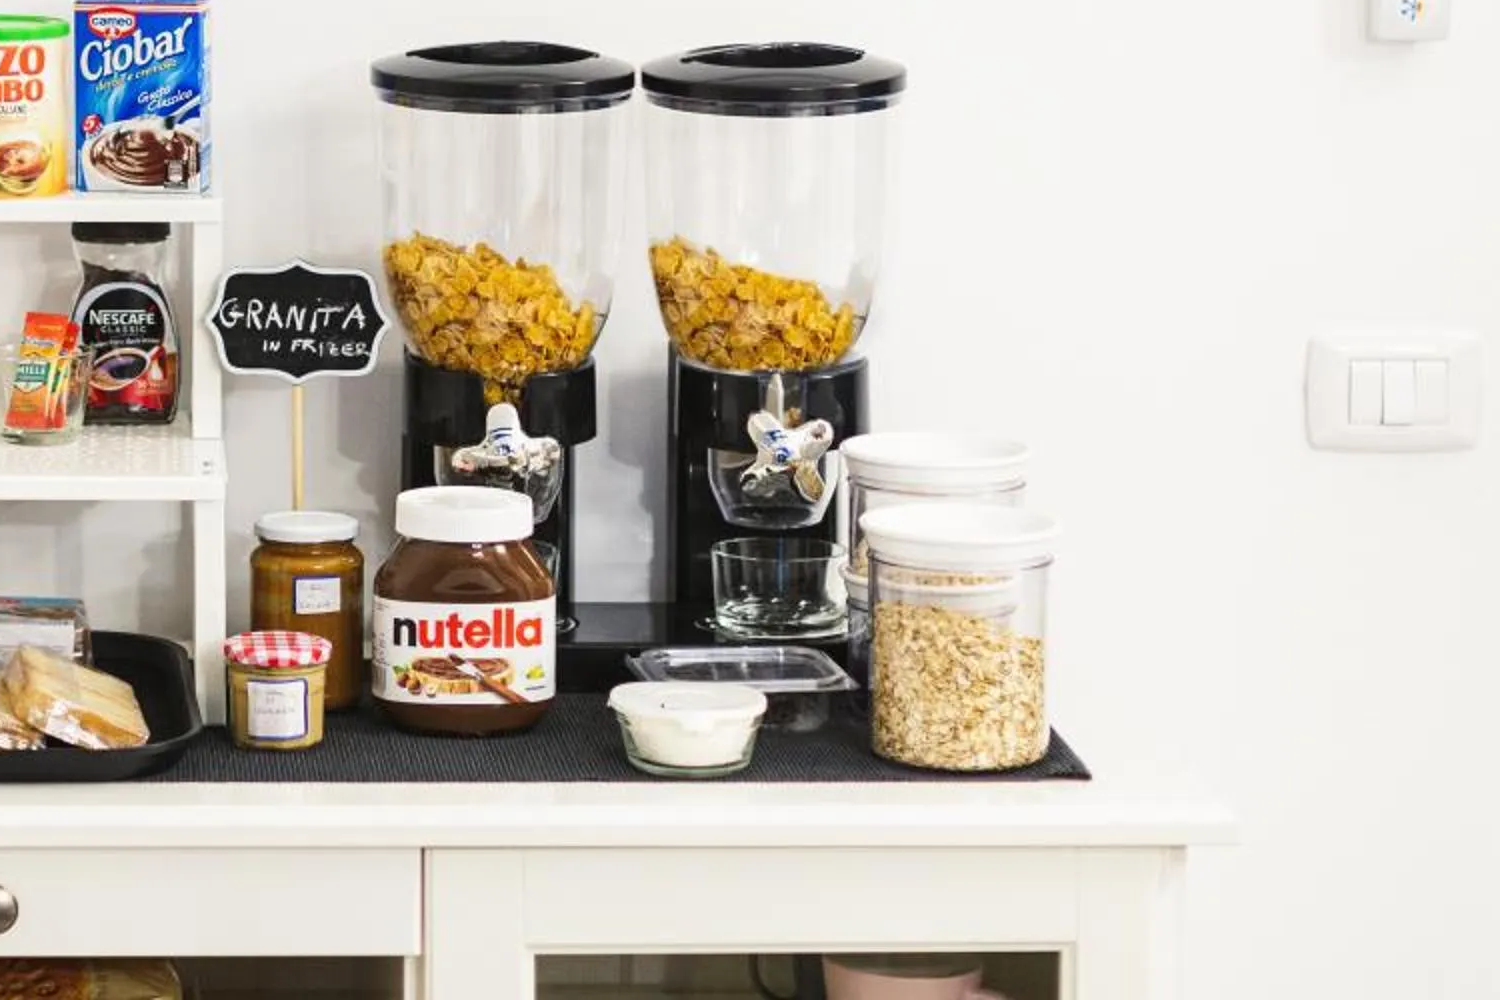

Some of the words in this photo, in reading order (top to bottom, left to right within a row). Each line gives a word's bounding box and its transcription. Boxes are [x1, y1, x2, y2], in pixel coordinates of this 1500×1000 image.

[92, 16, 132, 26] cameo
[80, 17, 193, 81] Ciobar
[101, 325, 147, 334] CLASSIC
[263, 339, 281, 352] IN
[393, 607, 543, 649] nutella
